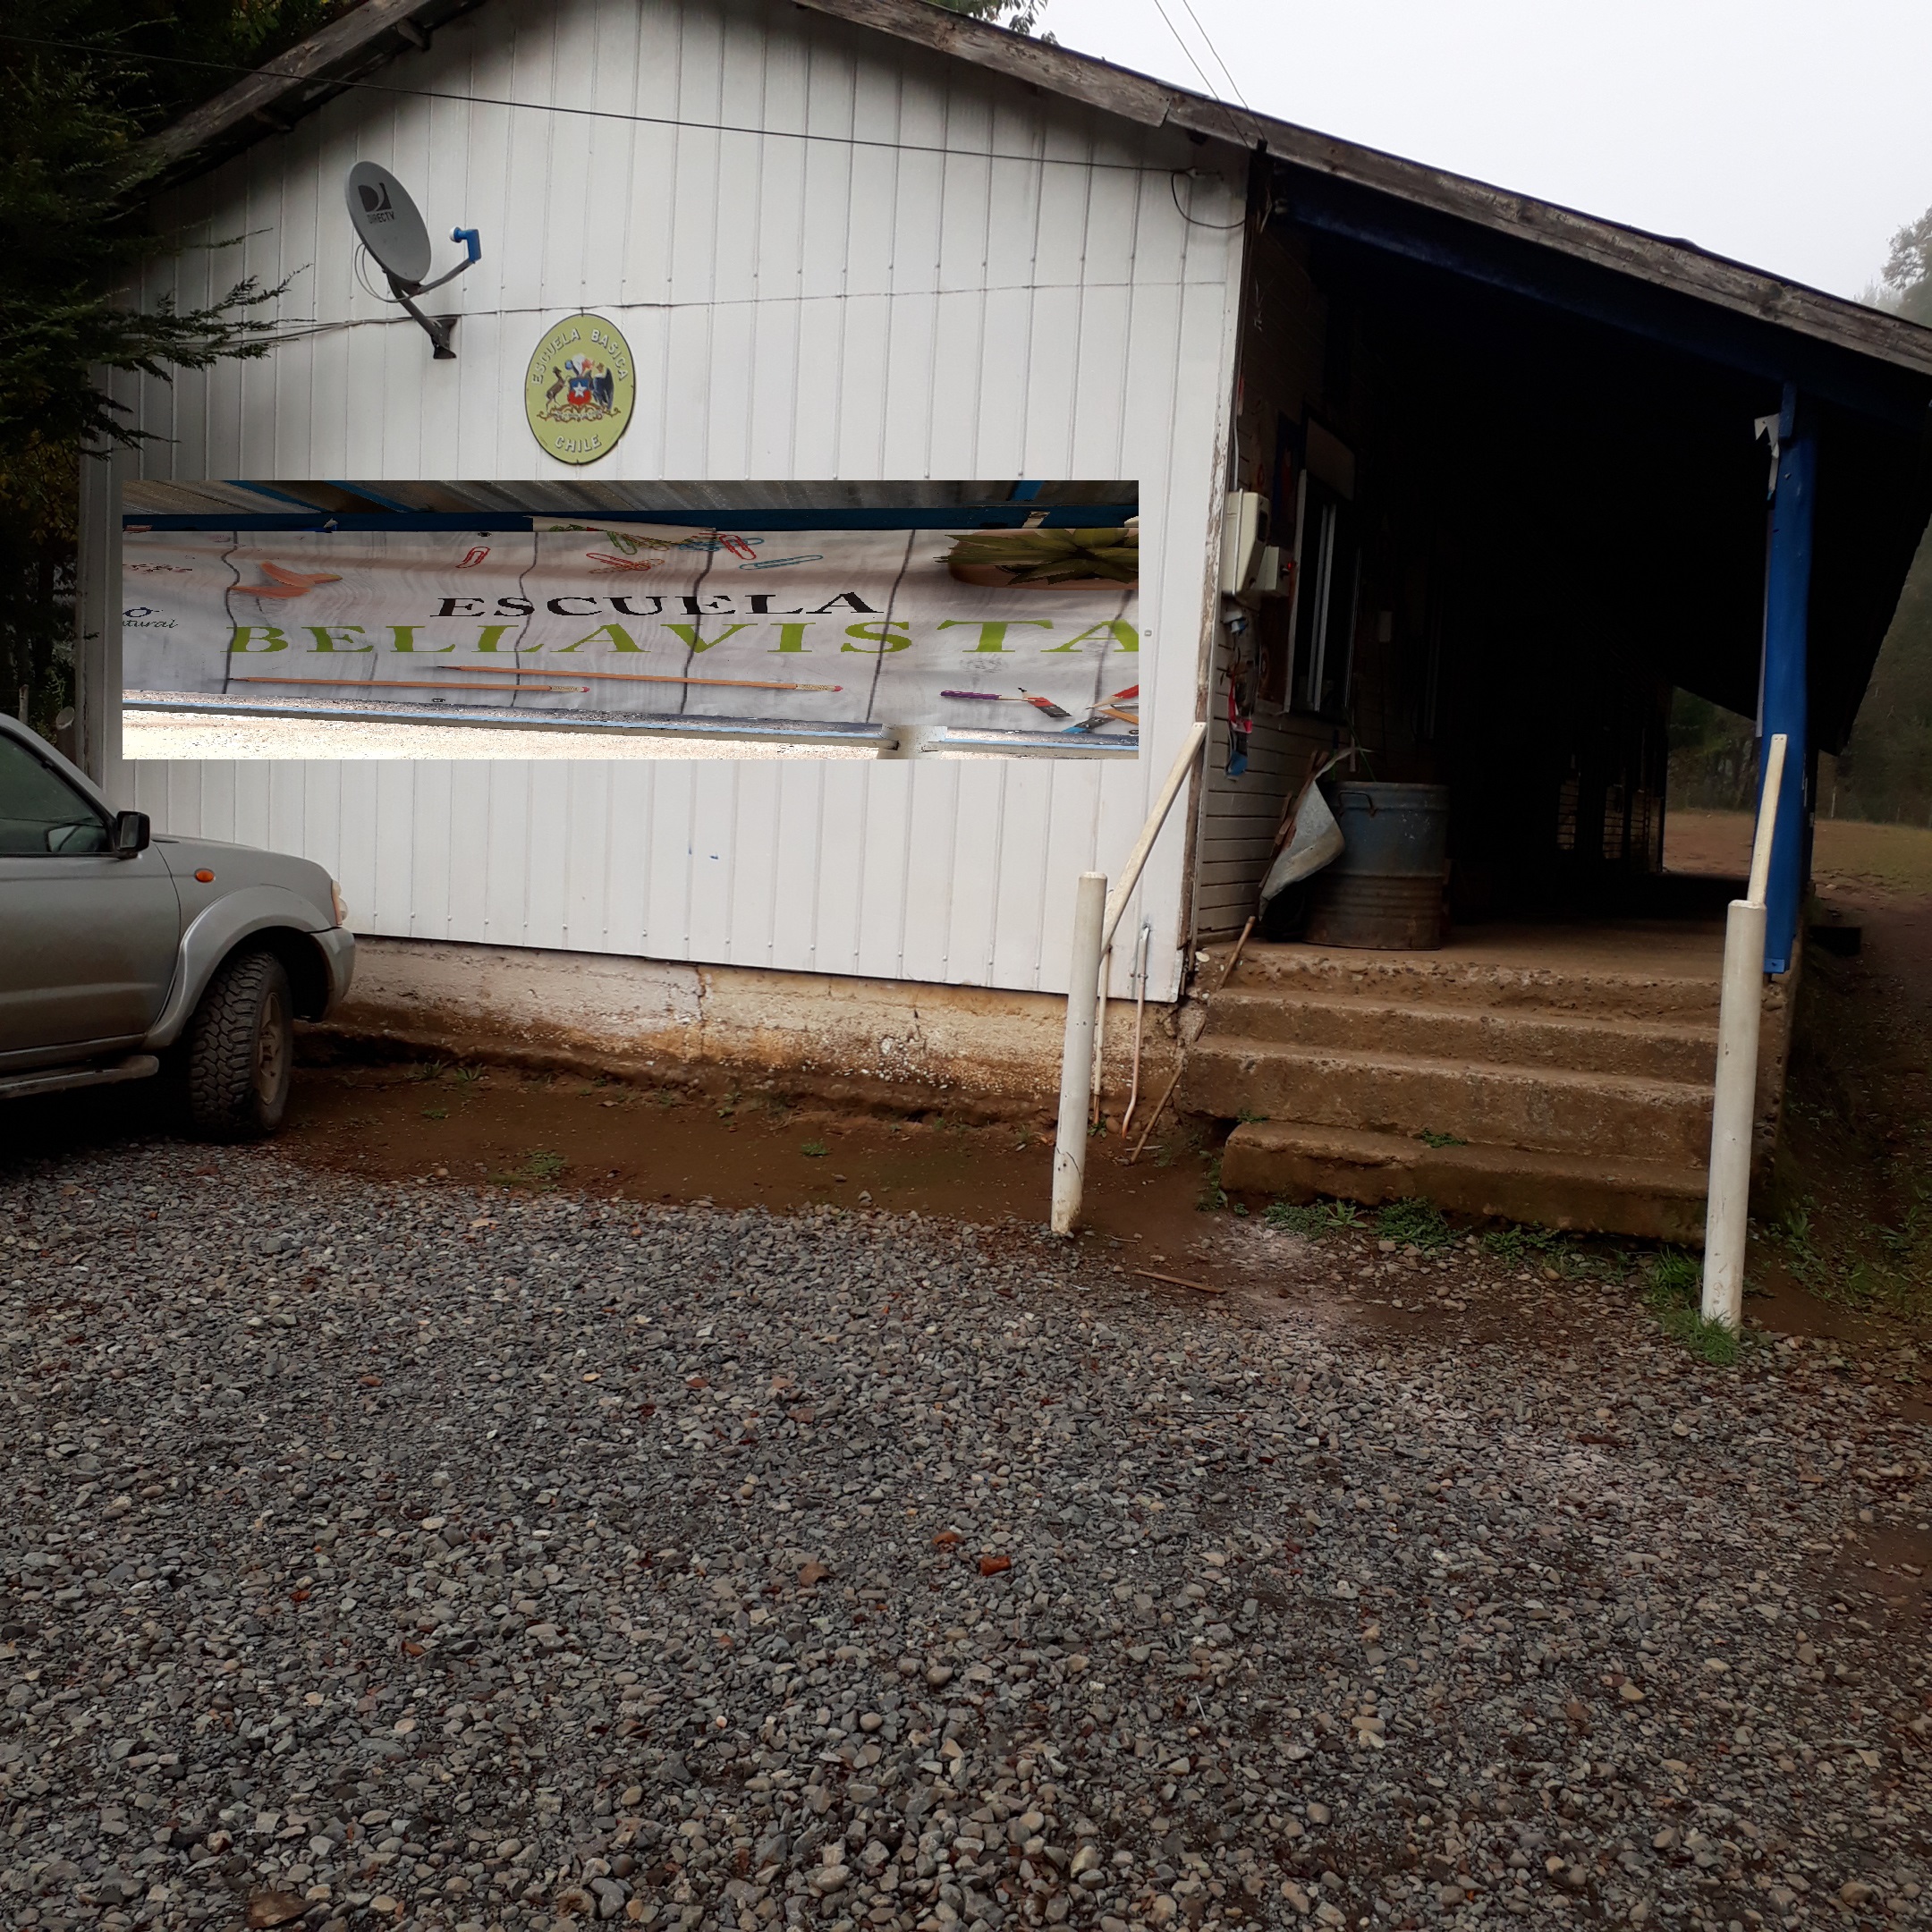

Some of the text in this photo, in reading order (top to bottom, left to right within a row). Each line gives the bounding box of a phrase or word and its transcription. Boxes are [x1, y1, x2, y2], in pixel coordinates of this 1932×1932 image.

[531, 328, 629, 385] ESCUELA BASICA
[555, 434, 602, 453] CHILE
[429, 590, 885, 618] ESCUELA
[219, 619, 1139, 654] BELLAVISTA
